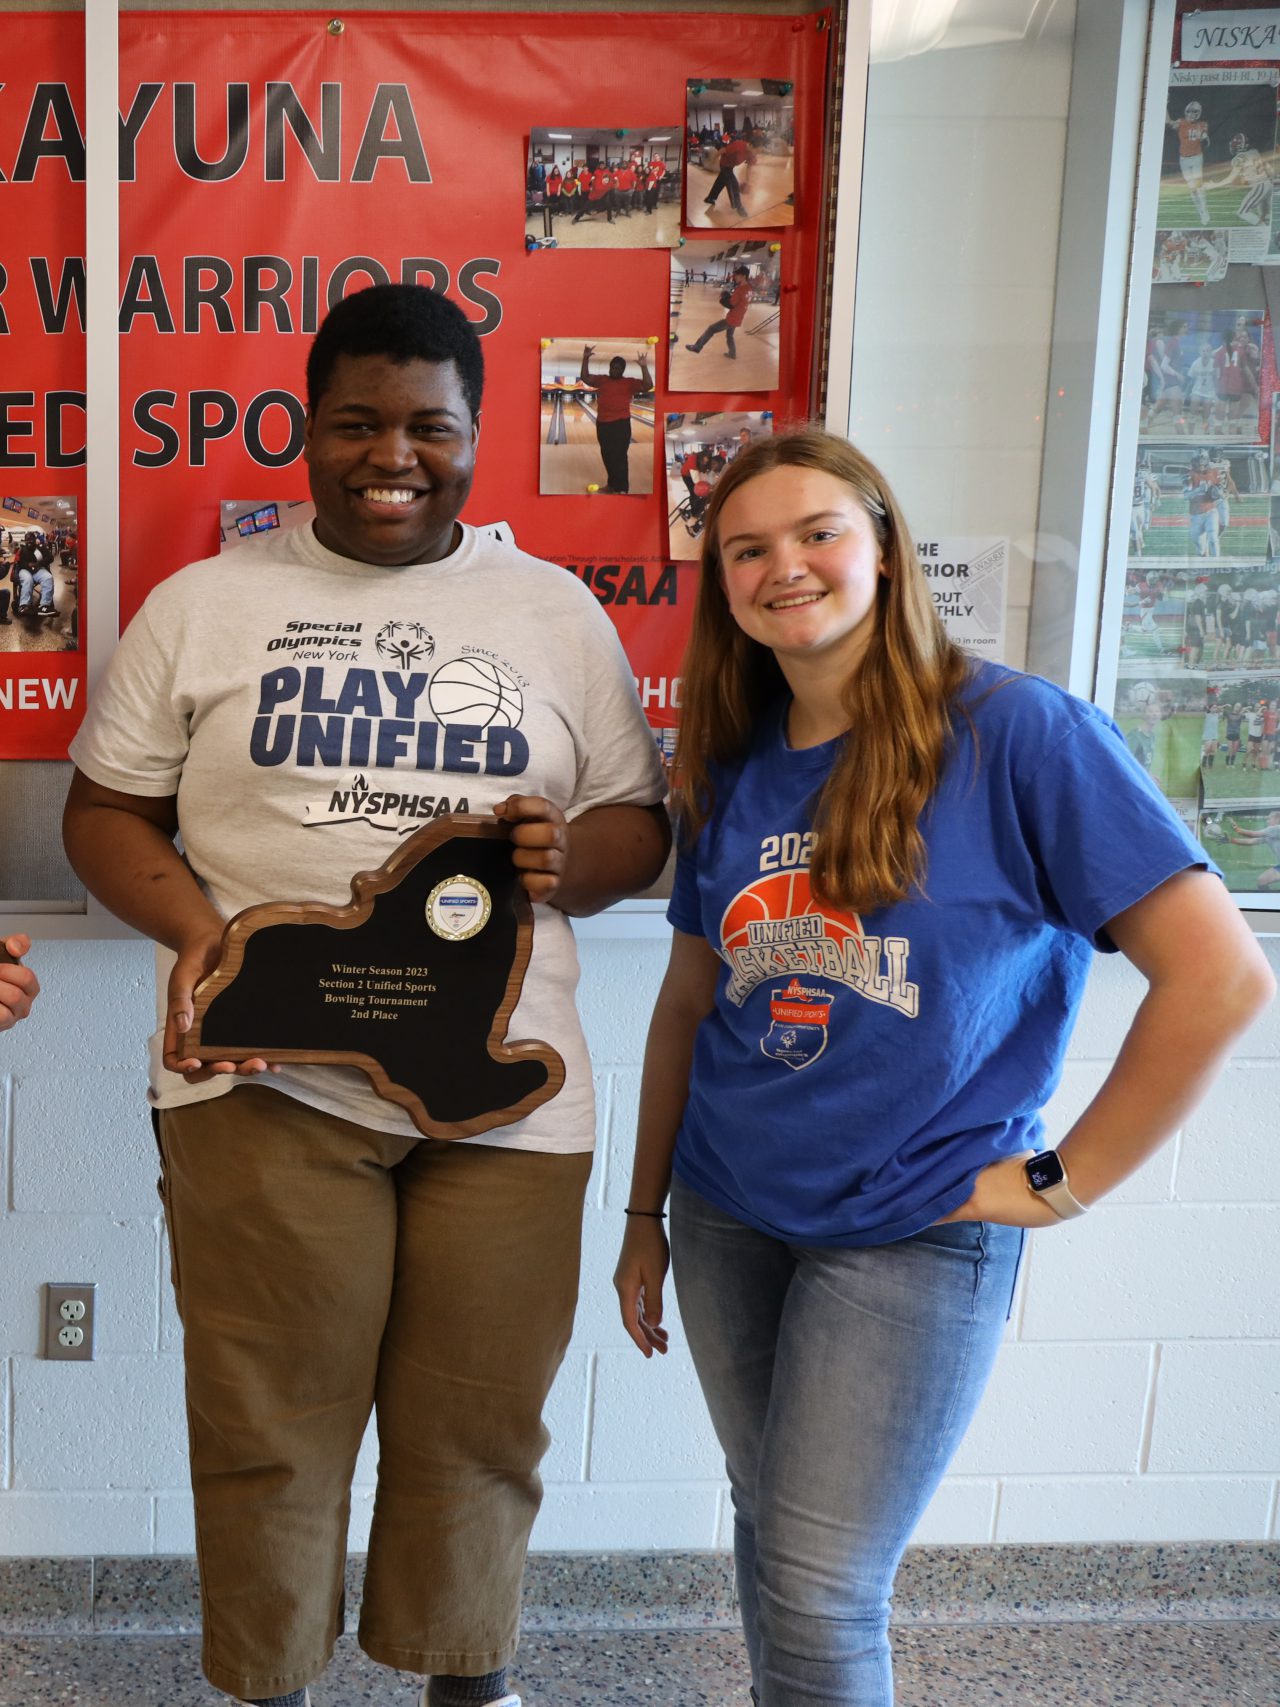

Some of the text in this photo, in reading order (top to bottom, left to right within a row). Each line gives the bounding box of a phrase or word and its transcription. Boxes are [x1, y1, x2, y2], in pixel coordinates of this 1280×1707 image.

[1193, 24, 1278, 49] NISKA
[132, 389, 306, 468] SPO
[922, 564, 969, 578] RIOR
[933, 592, 963, 604] OUT
[937, 605, 974, 617] THLY
[285, 621, 363, 634] Special
[266, 634, 363, 652] Olympics
[292, 649, 359, 662] New York
[461, 644, 499, 660] Since
[257, 666, 429, 720] PLAY
[250, 714, 530, 777] UNIFIED
[328, 790, 471, 819] NYSPHSAA
[759, 831, 819, 872] 202
[748, 915, 823, 945] UNIFIED
[331, 963, 428, 977] Winter Season 2023
[318, 978, 437, 994] Section 2 Unified Sports
[787, 985, 826, 997] NYSPHSAA
[324, 993, 428, 1007] Bowling Tournament
[350, 1009, 399, 1020] 2nd Place
[774, 1007, 803, 1018] UNIFIED
